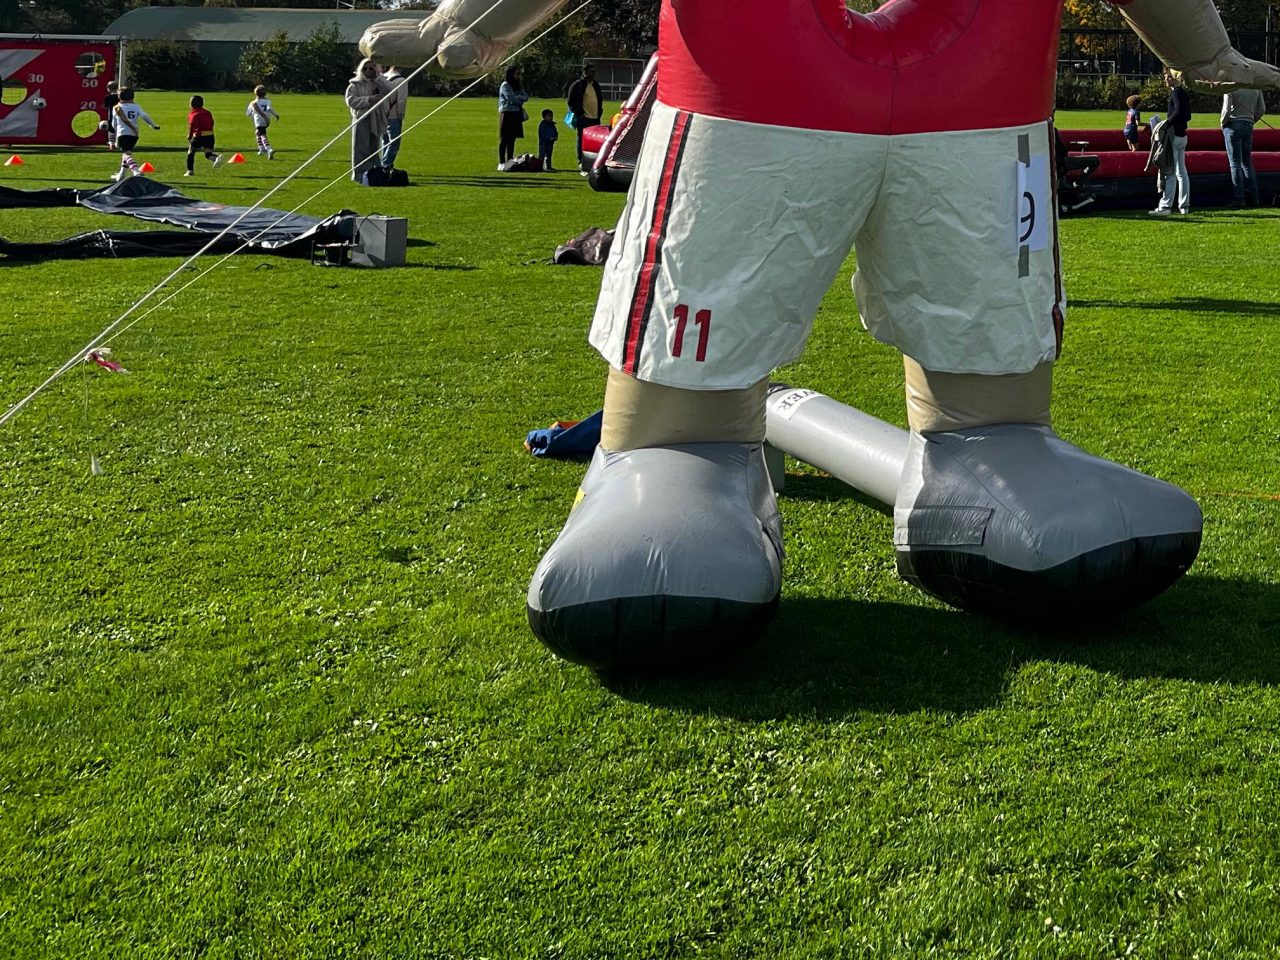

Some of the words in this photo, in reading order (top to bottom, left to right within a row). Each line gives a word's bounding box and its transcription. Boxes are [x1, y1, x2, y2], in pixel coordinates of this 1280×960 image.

[27, 73, 44, 83] 30
[81, 79, 98, 88] 50
[80, 101, 96, 110] 20
[127, 111, 135, 119] 6
[671, 303, 712, 362] 11
